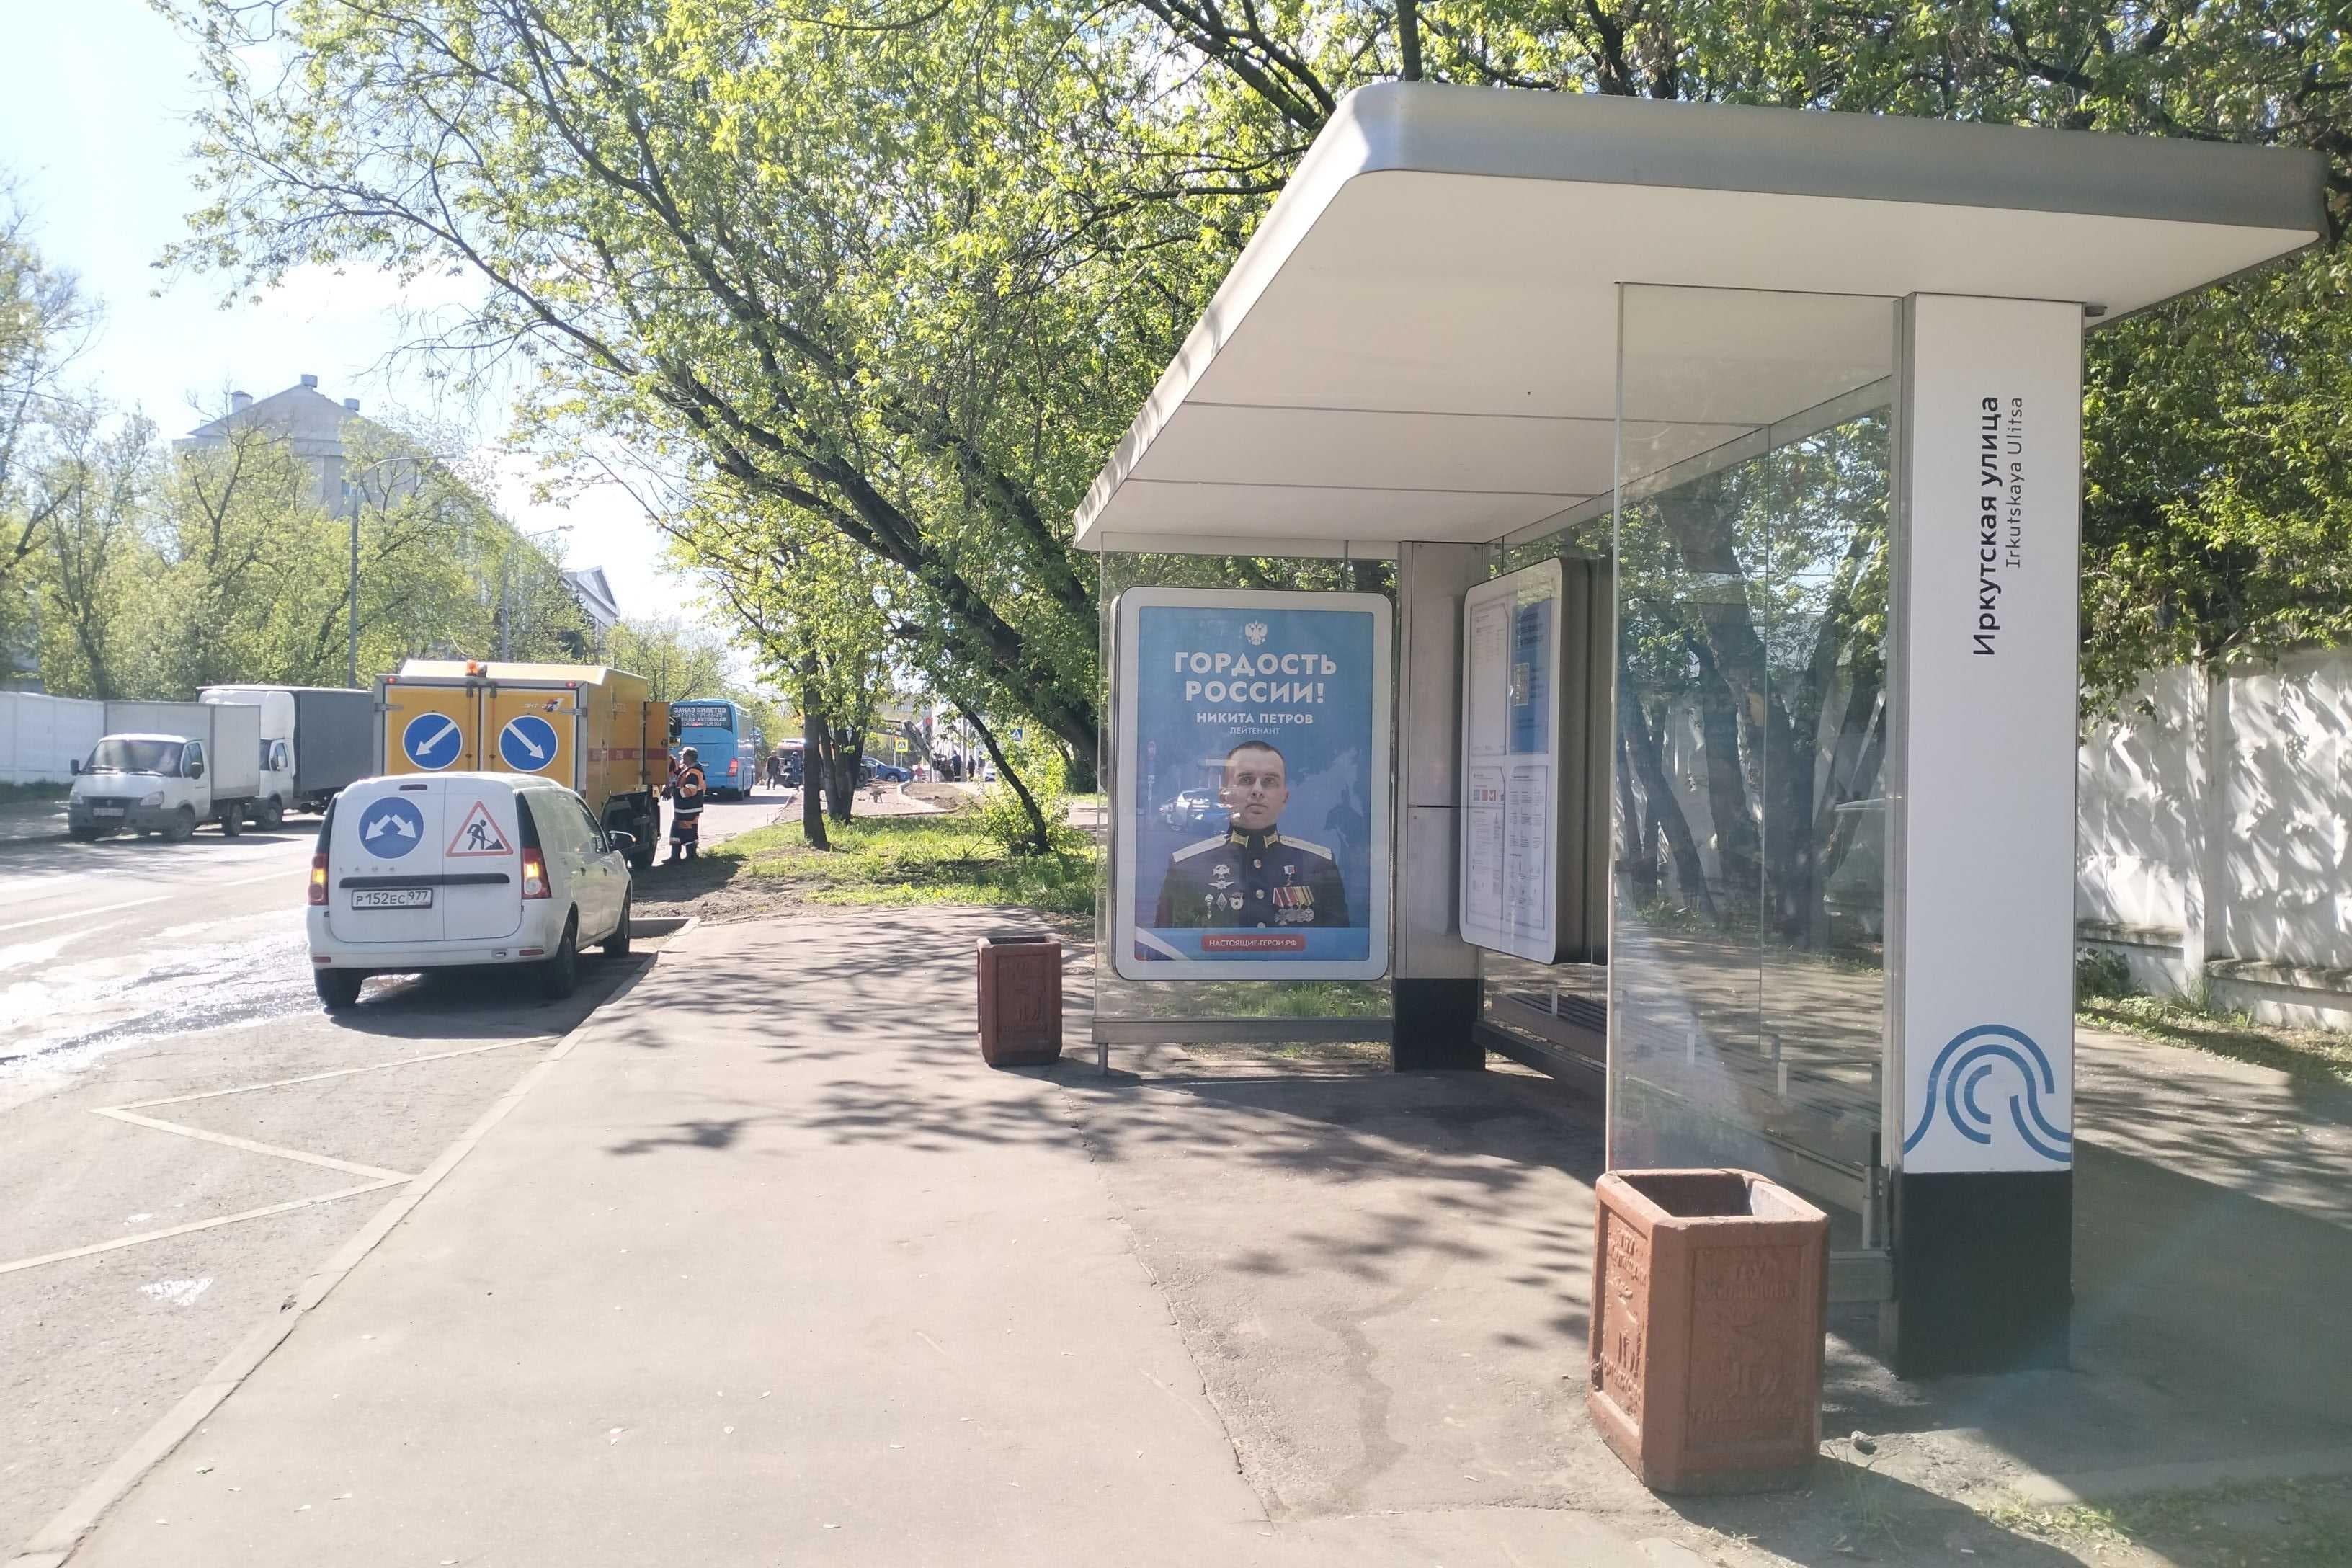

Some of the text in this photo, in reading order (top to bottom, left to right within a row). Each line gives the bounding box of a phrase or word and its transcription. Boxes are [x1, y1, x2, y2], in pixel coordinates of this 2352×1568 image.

[2005, 398, 2025, 568] Irkutskaya Ulitsa
[1973, 396, 2003, 655] Иркутская улица
[1175, 651, 1337, 677] ГОРДОСТЬ
[1185, 680, 1325, 704] РОССИИ!
[1196, 712, 1314, 724] НИКИТА ПЕТРОВ
[1229, 726, 1280, 735] ЛЕЙТЕНАНТ
